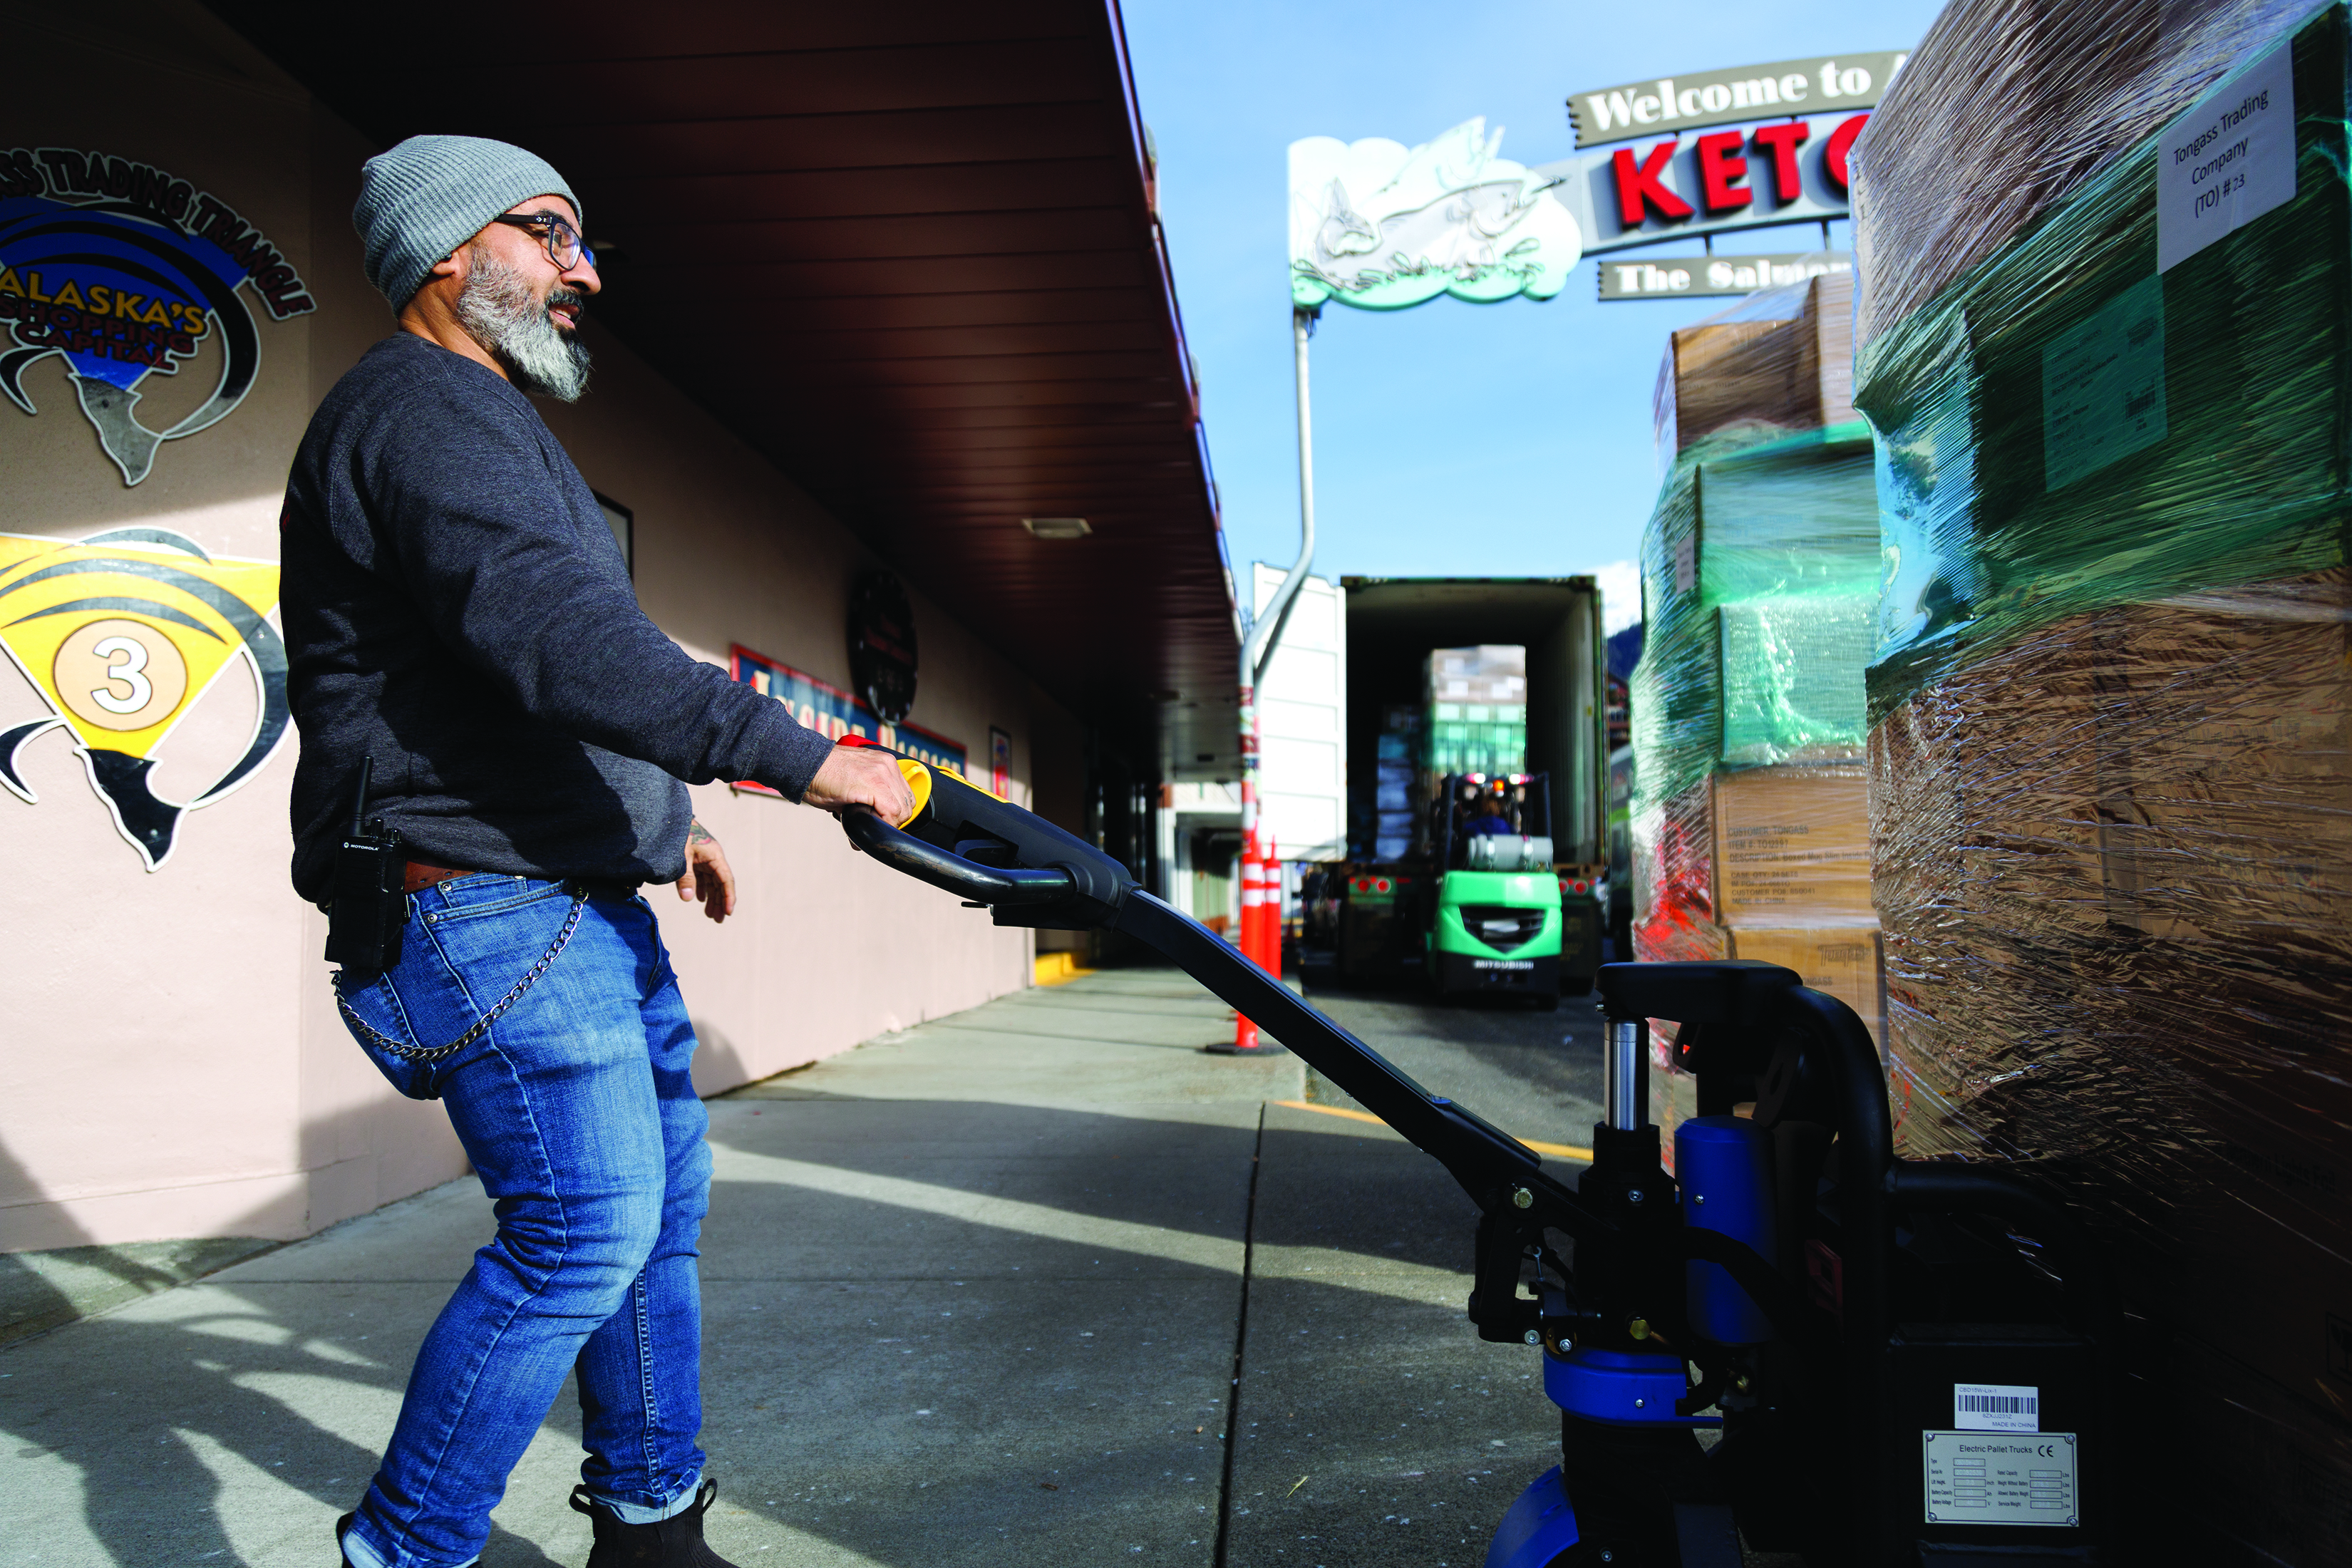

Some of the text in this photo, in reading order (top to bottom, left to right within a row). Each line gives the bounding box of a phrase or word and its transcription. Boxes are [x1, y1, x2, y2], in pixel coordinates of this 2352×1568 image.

[1587, 78, 1809, 131] Welcome
[1820, 61, 1872, 98] to
[2173, 90, 2269, 165] Tongass Trading
[2192, 138, 2249, 185] Company
[2195, 173, 2246, 219] (TO) # 23
[39, 150, 193, 219] TRADING
[194, 194, 314, 318] TRIANGLE
[0, 267, 205, 335] ALASKA'S
[1615, 264, 1692, 294] The
[0, 296, 195, 354] SHOPPING
[16, 321, 173, 370] CAPITAL
[91, 636, 153, 713] 3
[1728, 825, 1809, 837] CUSTOMER: TONGASS
[1728, 840, 1745, 850] ITEM
[1729, 852, 1780, 863] DESCRIPTION:
[1783, 852, 1806, 861] Boxed
[1807, 852, 1823, 862] Mug
[1825, 850, 1840, 860] Slim
[1842, 850, 1862, 860] Inside
[1474, 960, 1534, 969] MITSUBISHI
